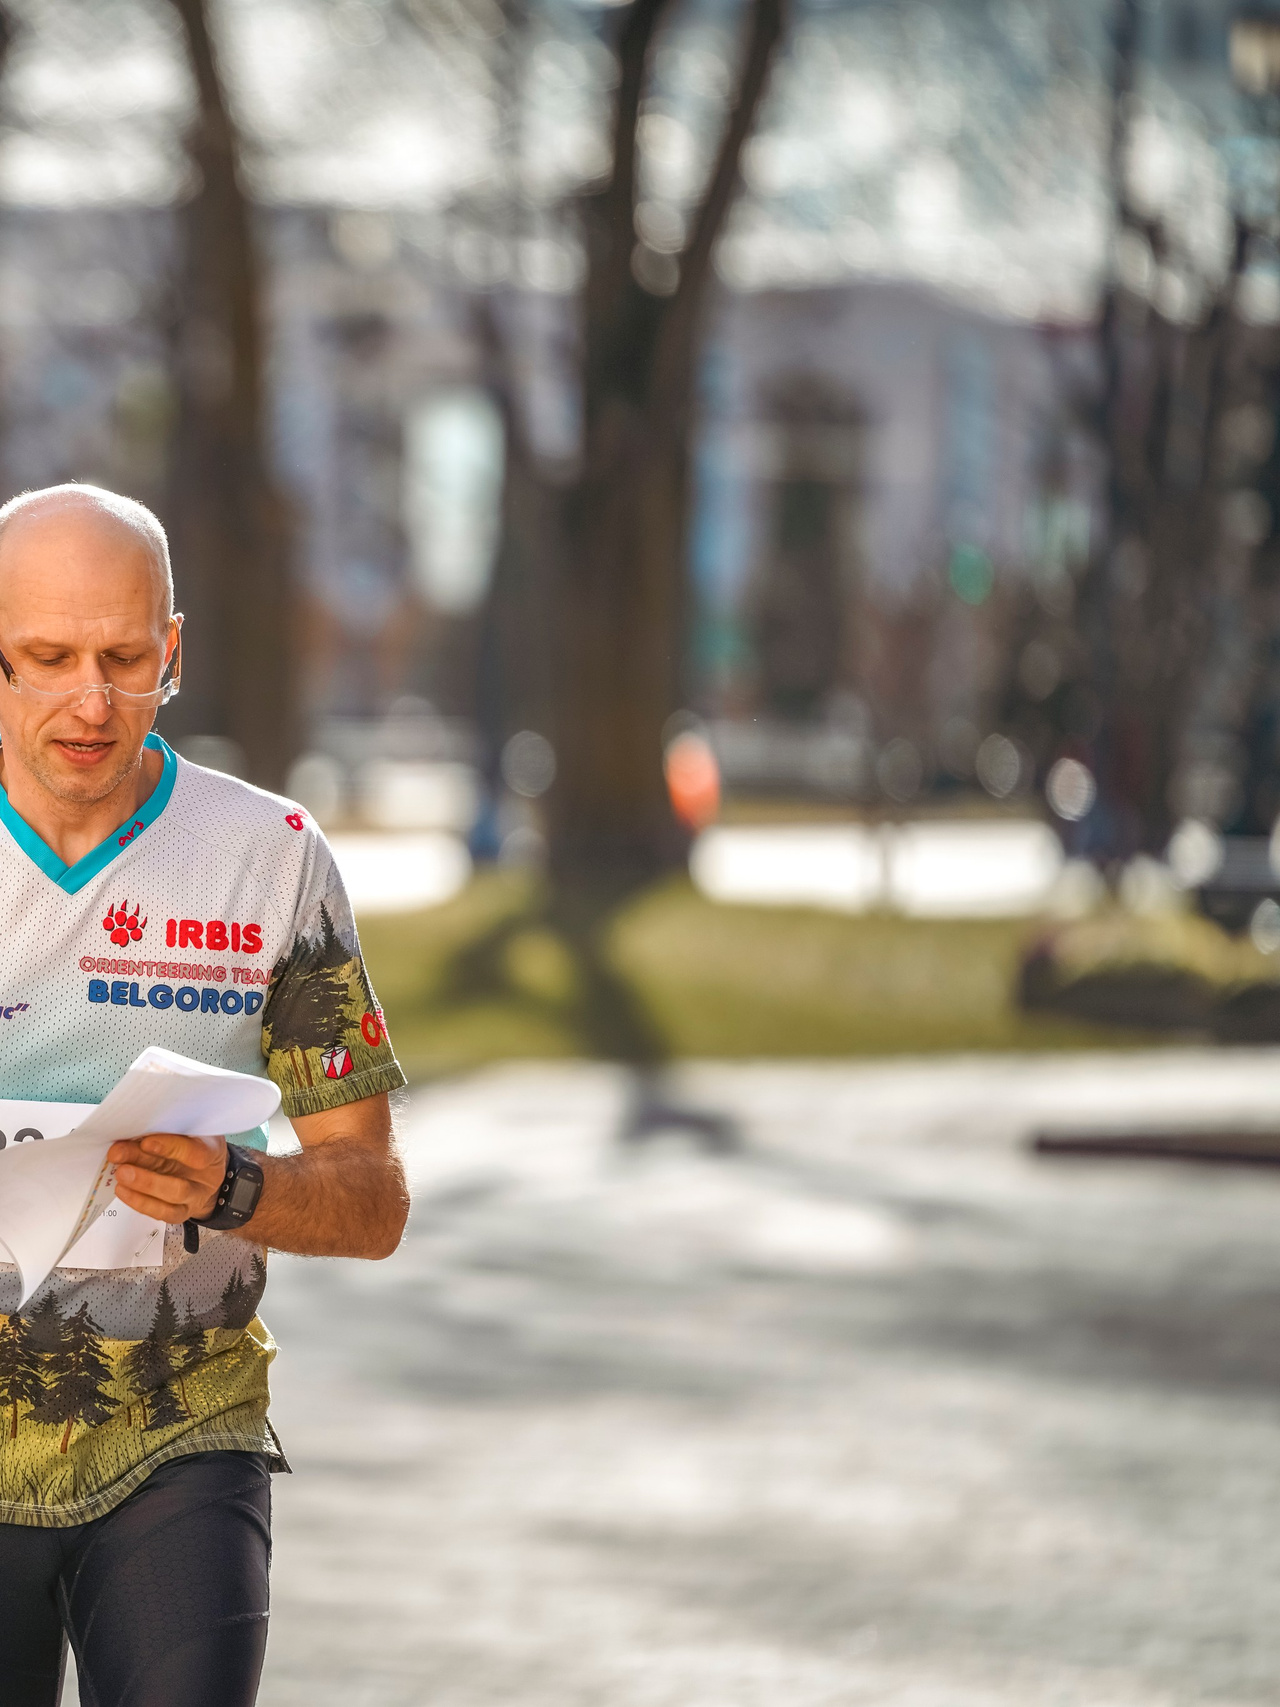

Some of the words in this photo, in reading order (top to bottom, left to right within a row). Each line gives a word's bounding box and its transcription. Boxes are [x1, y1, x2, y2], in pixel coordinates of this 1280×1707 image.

[166, 918, 263, 954] IRBIS
[79, 956, 227, 983] ORIENTEERING
[88, 978, 264, 1016] BELGOROD
